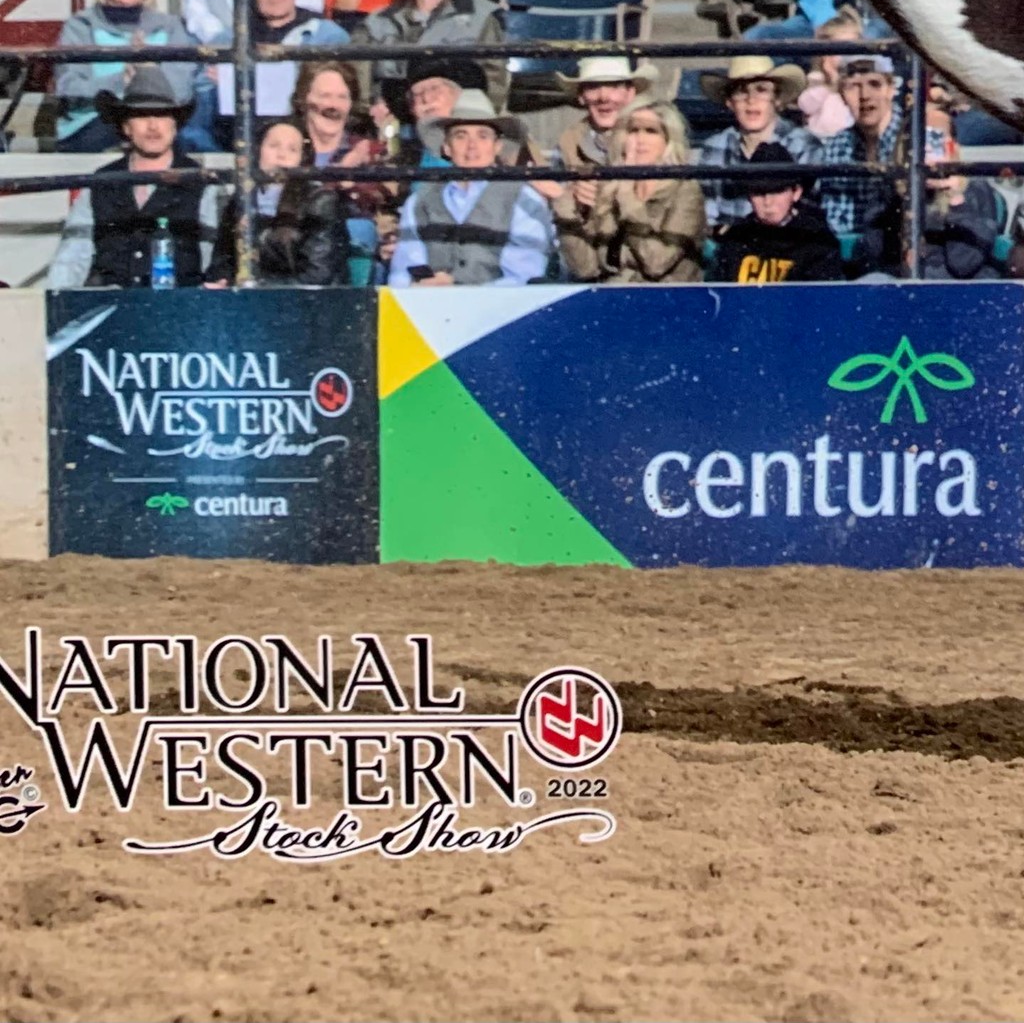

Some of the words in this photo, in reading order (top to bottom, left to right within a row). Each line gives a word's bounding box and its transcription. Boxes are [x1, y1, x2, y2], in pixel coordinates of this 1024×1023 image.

[76, 347, 291, 397] NATIONAL
[112, 391, 318, 436] WESTERN
[642, 434, 983, 519] centura
[194, 492, 289, 517] centura
